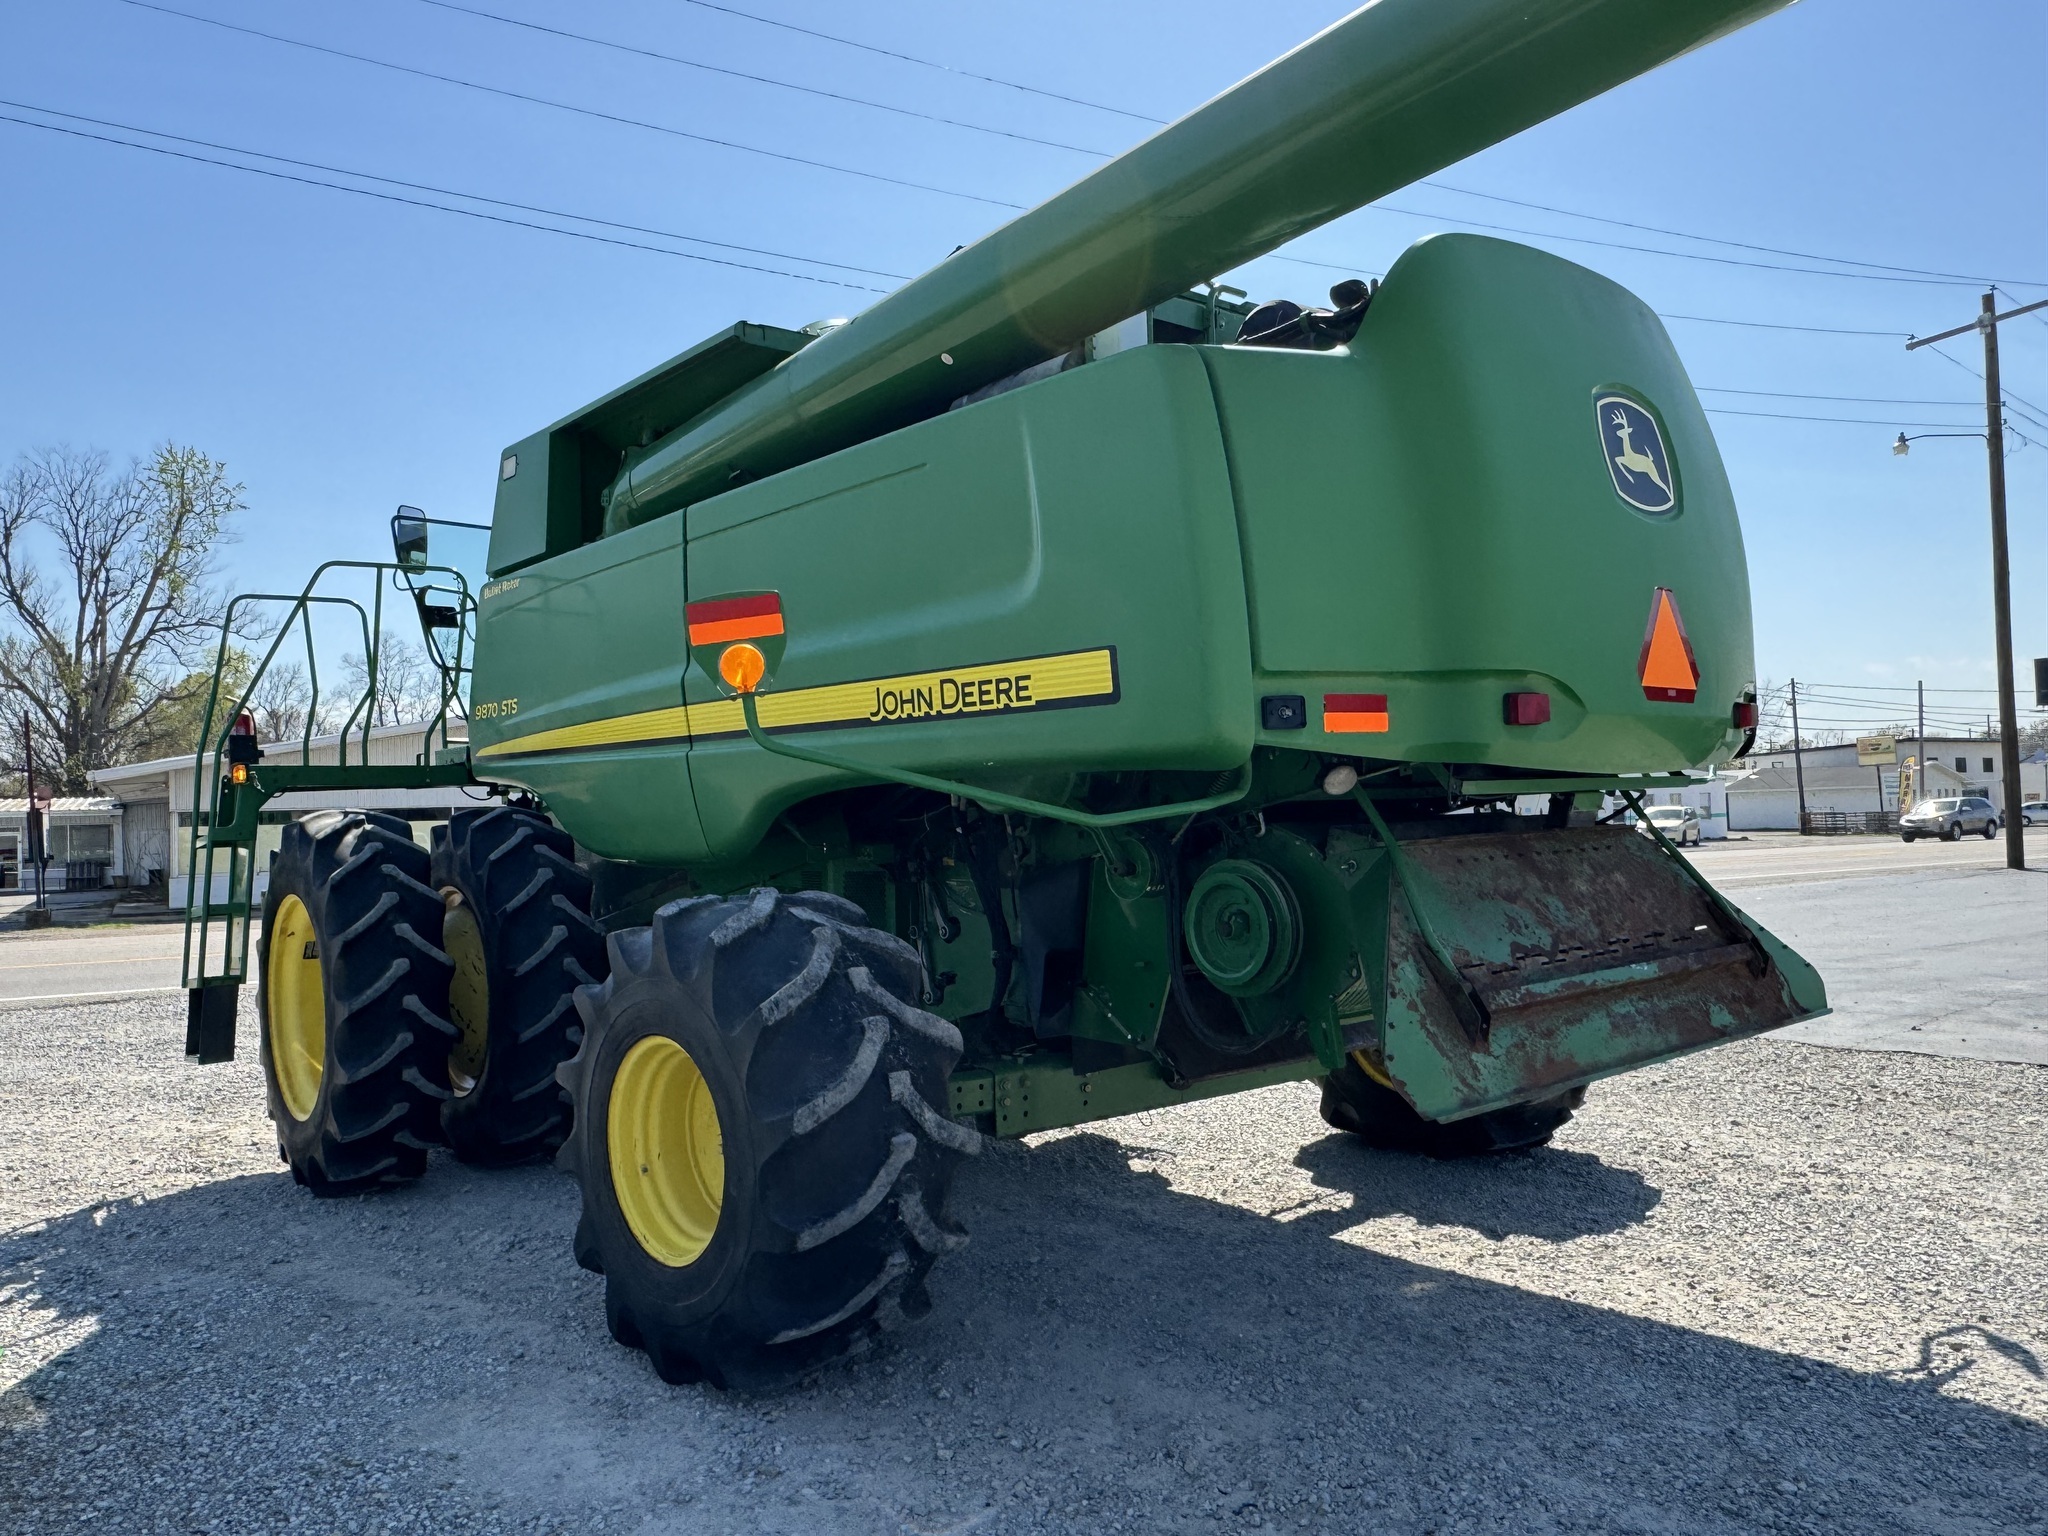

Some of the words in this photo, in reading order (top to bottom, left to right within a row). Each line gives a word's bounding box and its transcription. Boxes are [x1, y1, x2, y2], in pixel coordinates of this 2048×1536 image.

[475, 702, 498, 720] 9870
[501, 698, 518, 716] STS
[870, 686, 934, 717] JOHN
[939, 674, 1033, 710] DEERE
